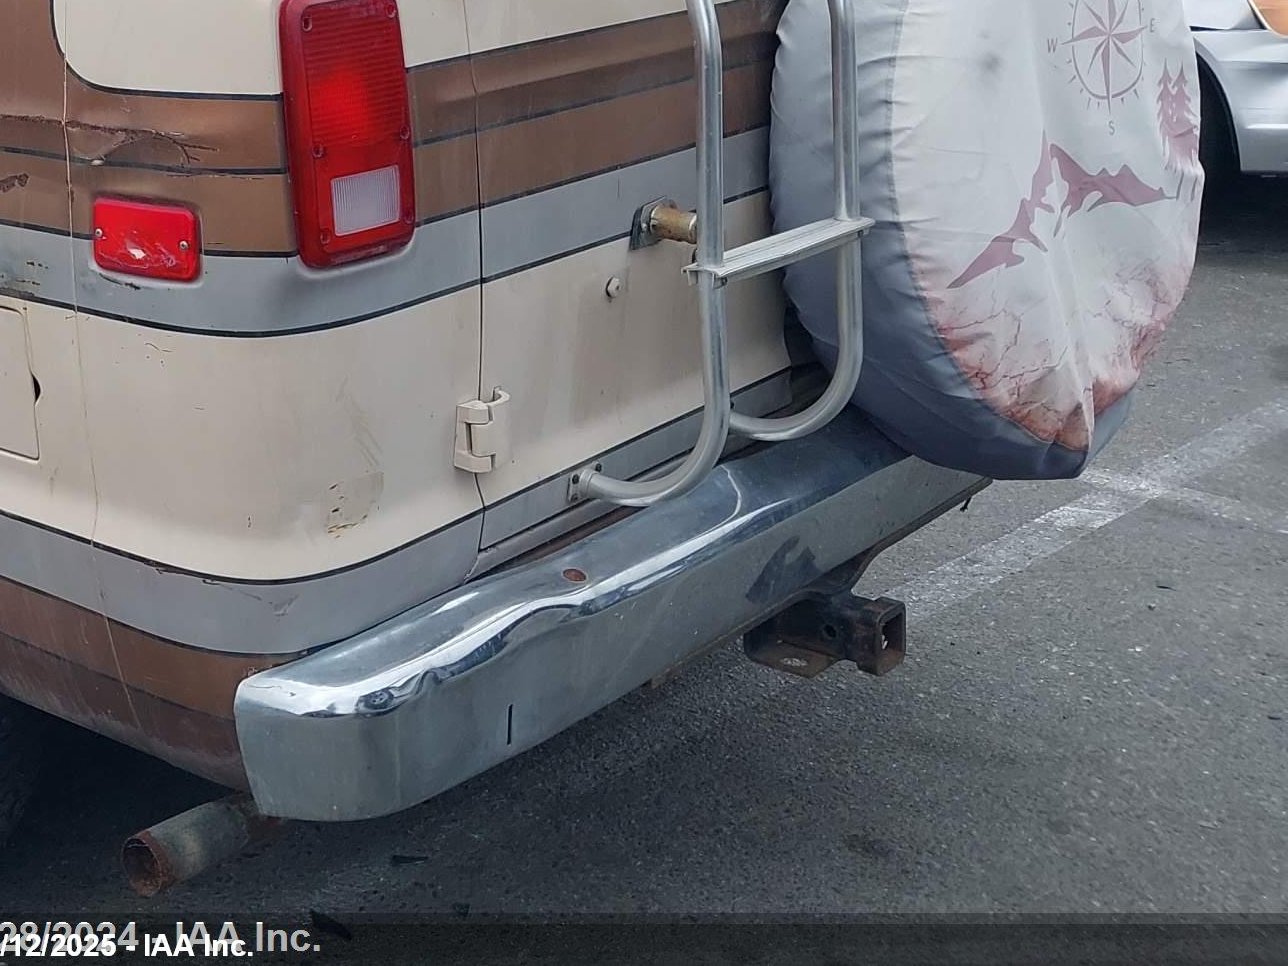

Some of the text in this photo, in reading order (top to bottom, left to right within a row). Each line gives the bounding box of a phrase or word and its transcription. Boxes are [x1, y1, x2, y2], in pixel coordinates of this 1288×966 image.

[1149, 17, 1156, 33] E
[1047, 38, 1058, 53] W
[1108, 120, 1116, 136] S
